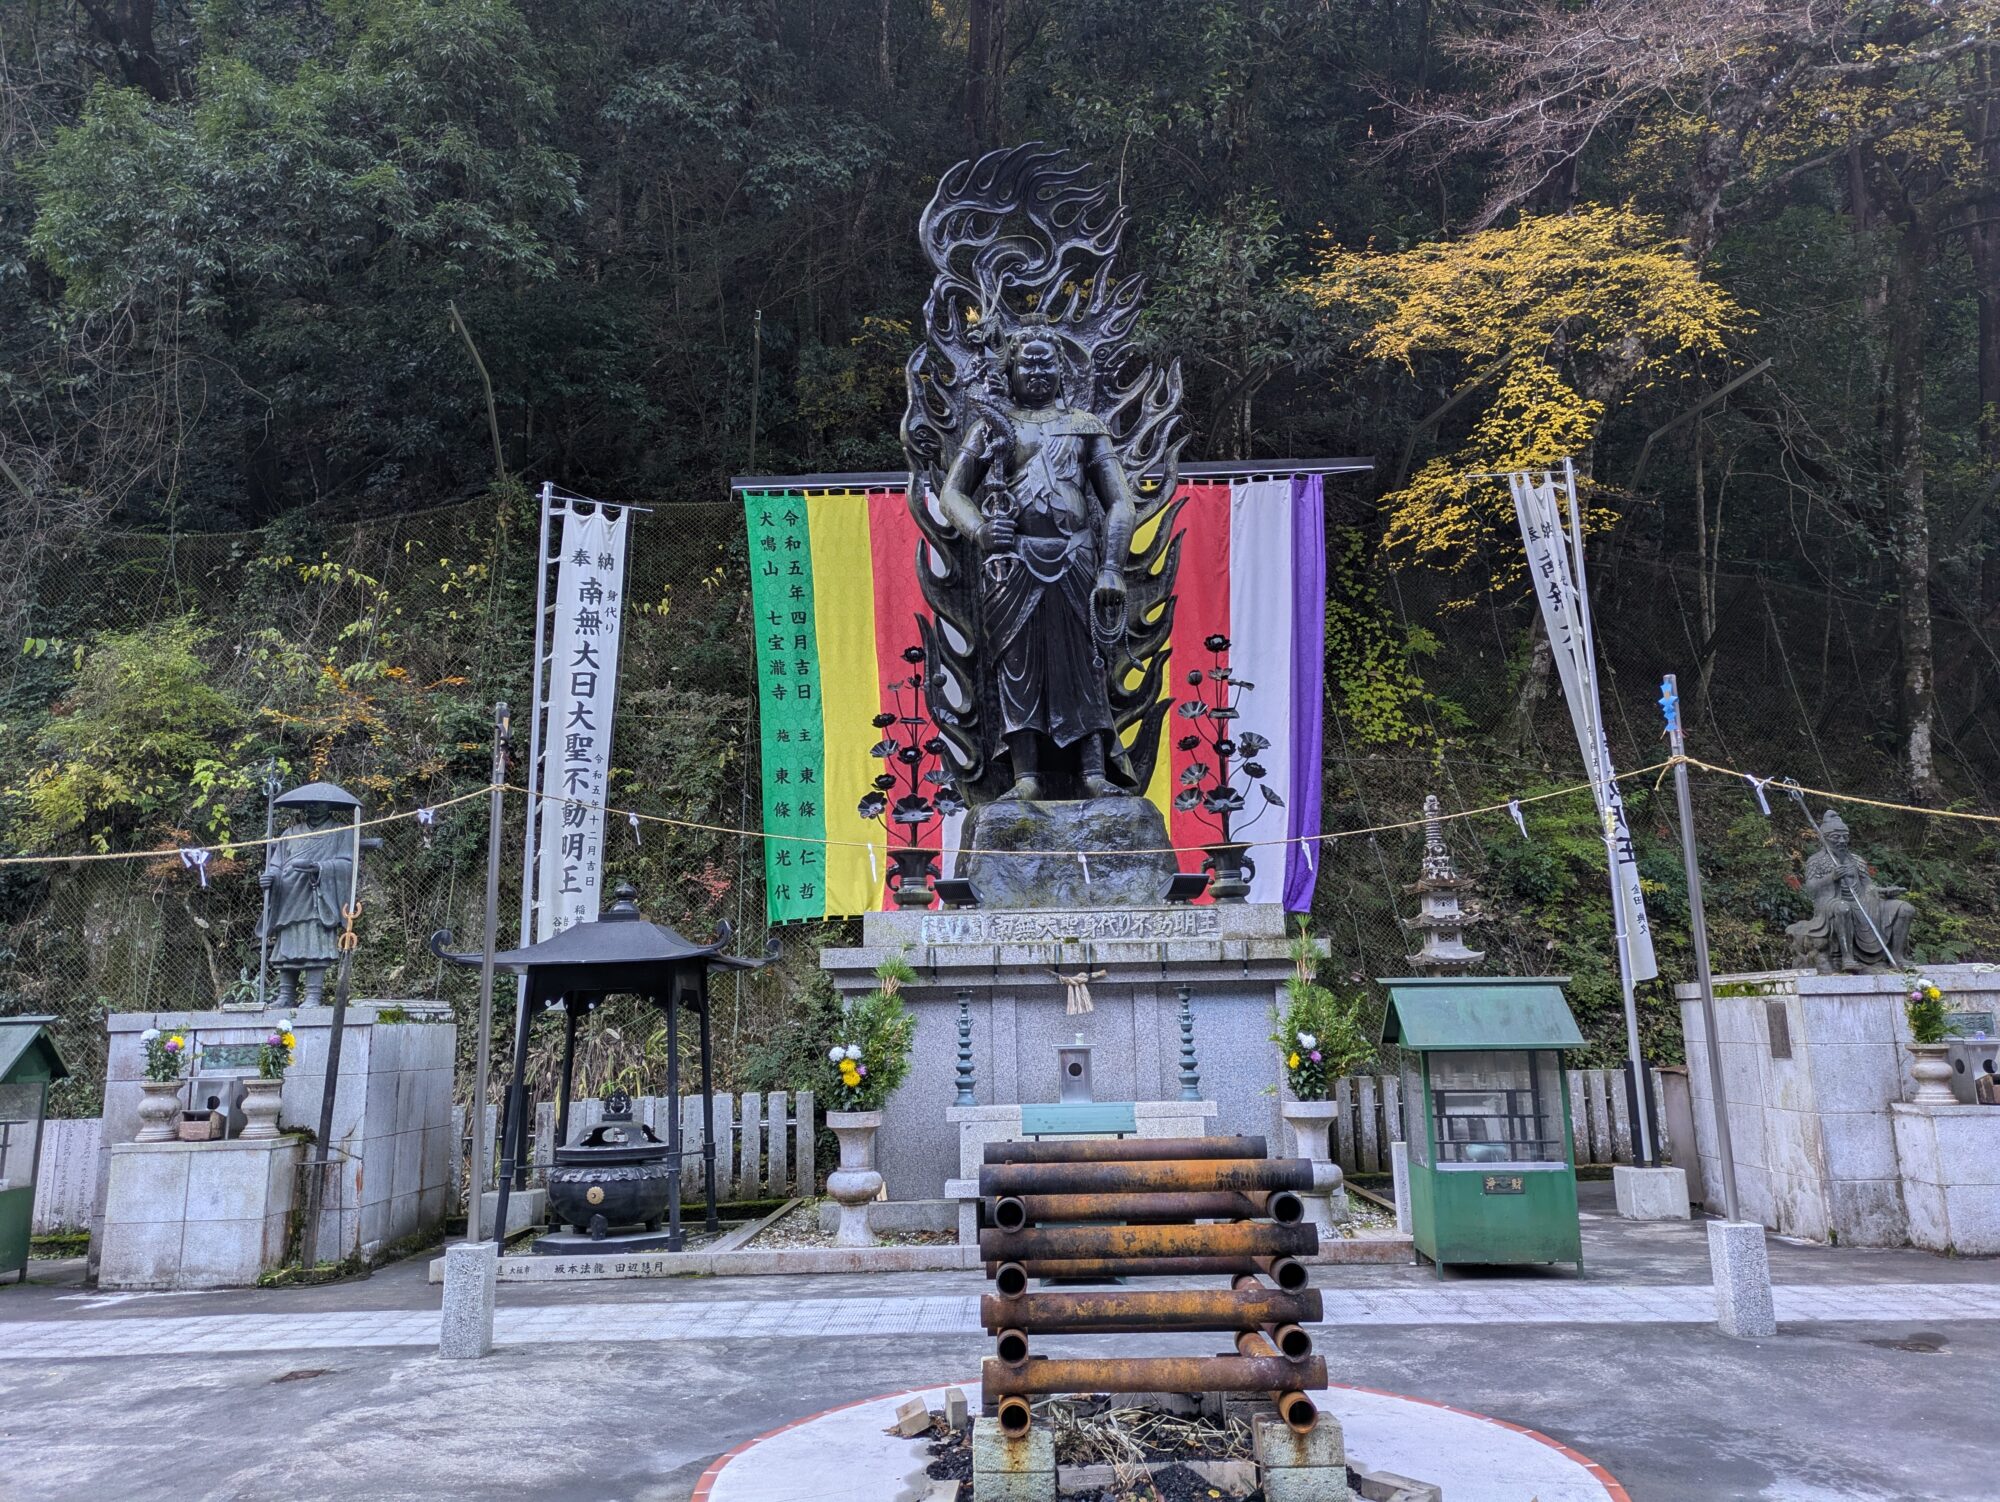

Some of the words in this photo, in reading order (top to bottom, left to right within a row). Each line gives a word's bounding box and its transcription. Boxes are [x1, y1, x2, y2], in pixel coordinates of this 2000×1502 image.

[570, 548, 615, 571] 奉納
[759, 511, 779, 576] 犬鳴山
[604, 590, 618, 634] 身代り
[782, 509, 811, 699] 令和五年四月吉日
[558, 577, 604, 895] 南無大日大聖不動明王
[585, 753, 605, 887] 令和五年十二月吉日
